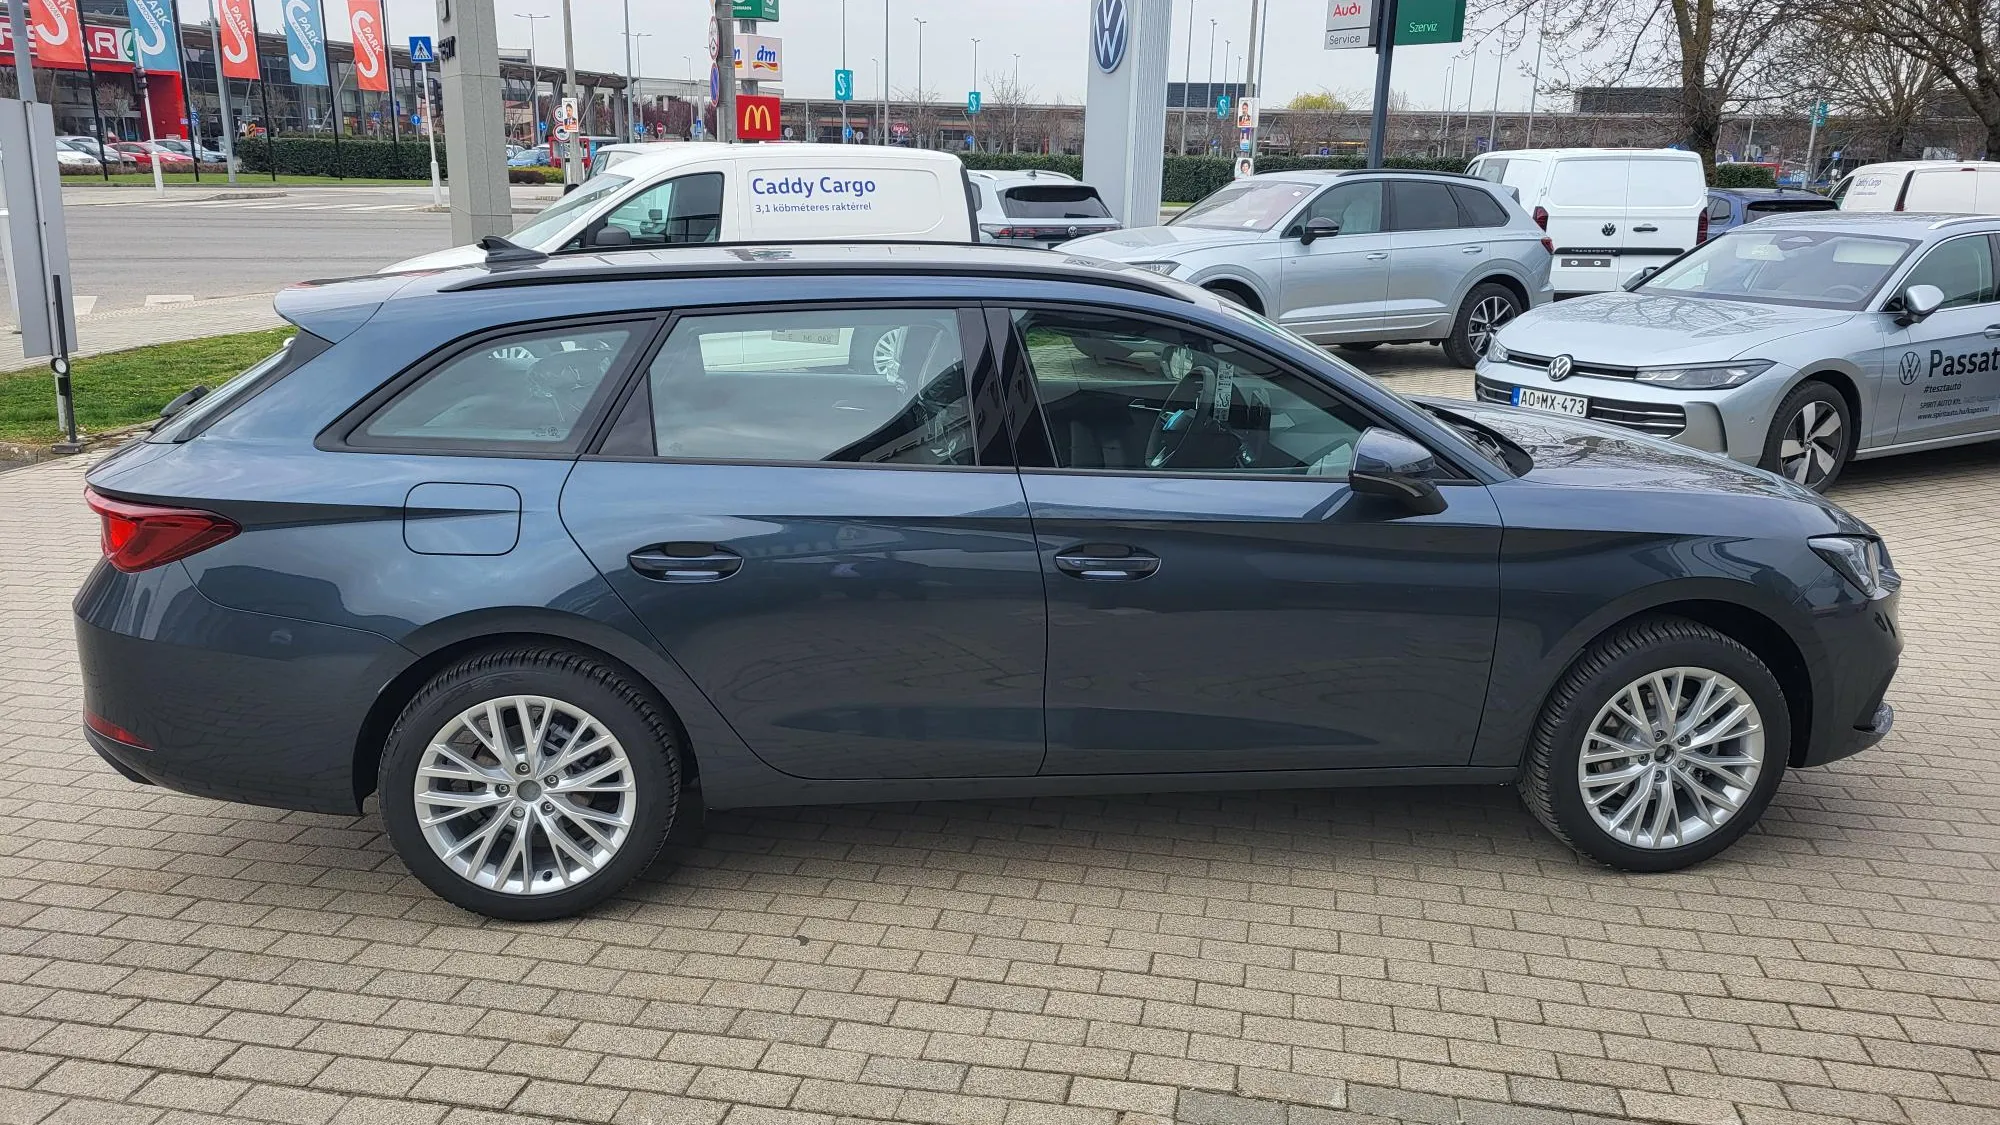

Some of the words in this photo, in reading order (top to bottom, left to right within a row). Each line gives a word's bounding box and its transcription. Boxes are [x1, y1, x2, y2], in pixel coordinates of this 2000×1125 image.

[1332, 3, 1361, 17] Audi
[231, 6, 253, 38] PARK
[298, 17, 322, 46] PARK
[1409, 21, 1438, 33] Szerviz
[362, 26, 383, 56] PARK
[1329, 34, 1361, 45] Service
[757, 45, 776, 62] dm
[752, 177, 814, 198] Caddy
[819, 176, 876, 197] Cargo
[755, 204, 771, 214] 3,1
[773, 202, 830, 213] köbméteres
[831, 202, 872, 212] raktérrel
[1928, 347, 2000, 378] Passat
